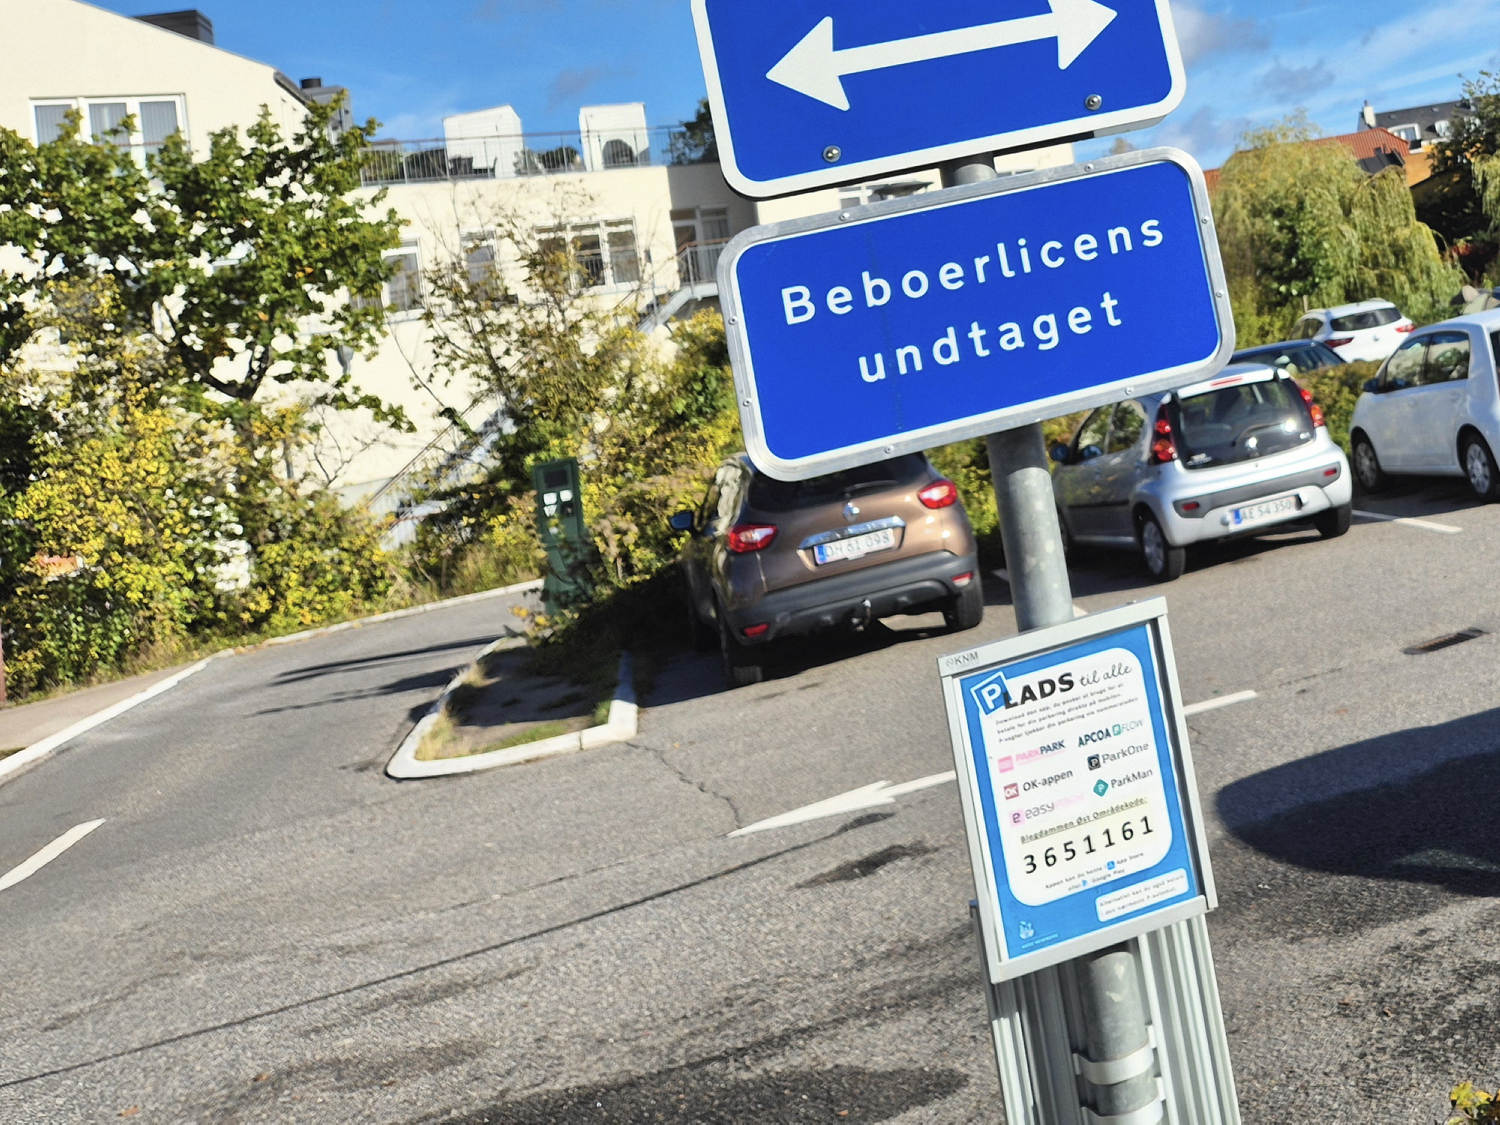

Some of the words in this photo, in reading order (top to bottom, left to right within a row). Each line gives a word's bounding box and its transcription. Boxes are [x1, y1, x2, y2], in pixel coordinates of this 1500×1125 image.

[781, 218, 1164, 326] Beboerlicens
[858, 291, 1122, 383] undtaget
[954, 651, 979, 667] KNM
[980, 672, 1075, 710] PLADS
[1079, 669, 1100, 687] til
[1102, 662, 1133, 681] alle
[995, 713, 1025, 725] Download
[1090, 688, 1107, 697] bruge
[997, 726, 1015, 734] betale
[1038, 710, 1066, 723] parkering
[1067, 703, 1088, 713] direkte
[1089, 699, 1097, 707] på
[1057, 713, 1086, 726] parkering
[1077, 728, 1112, 748] APCOA
[1121, 718, 1145, 733] FLOW
[1101, 742, 1149, 764] ParkOne
[1005, 786, 1019, 798] OK
[1022, 770, 1074, 792] OK-appen
[1110, 768, 1153, 789] ParkMan
[1020, 820, 1075, 845] Blegdammen
[1075, 815, 1091, 826] Øst
[1092, 797, 1148, 819] Områdekode:
[1091, 872, 1112, 884] Google
